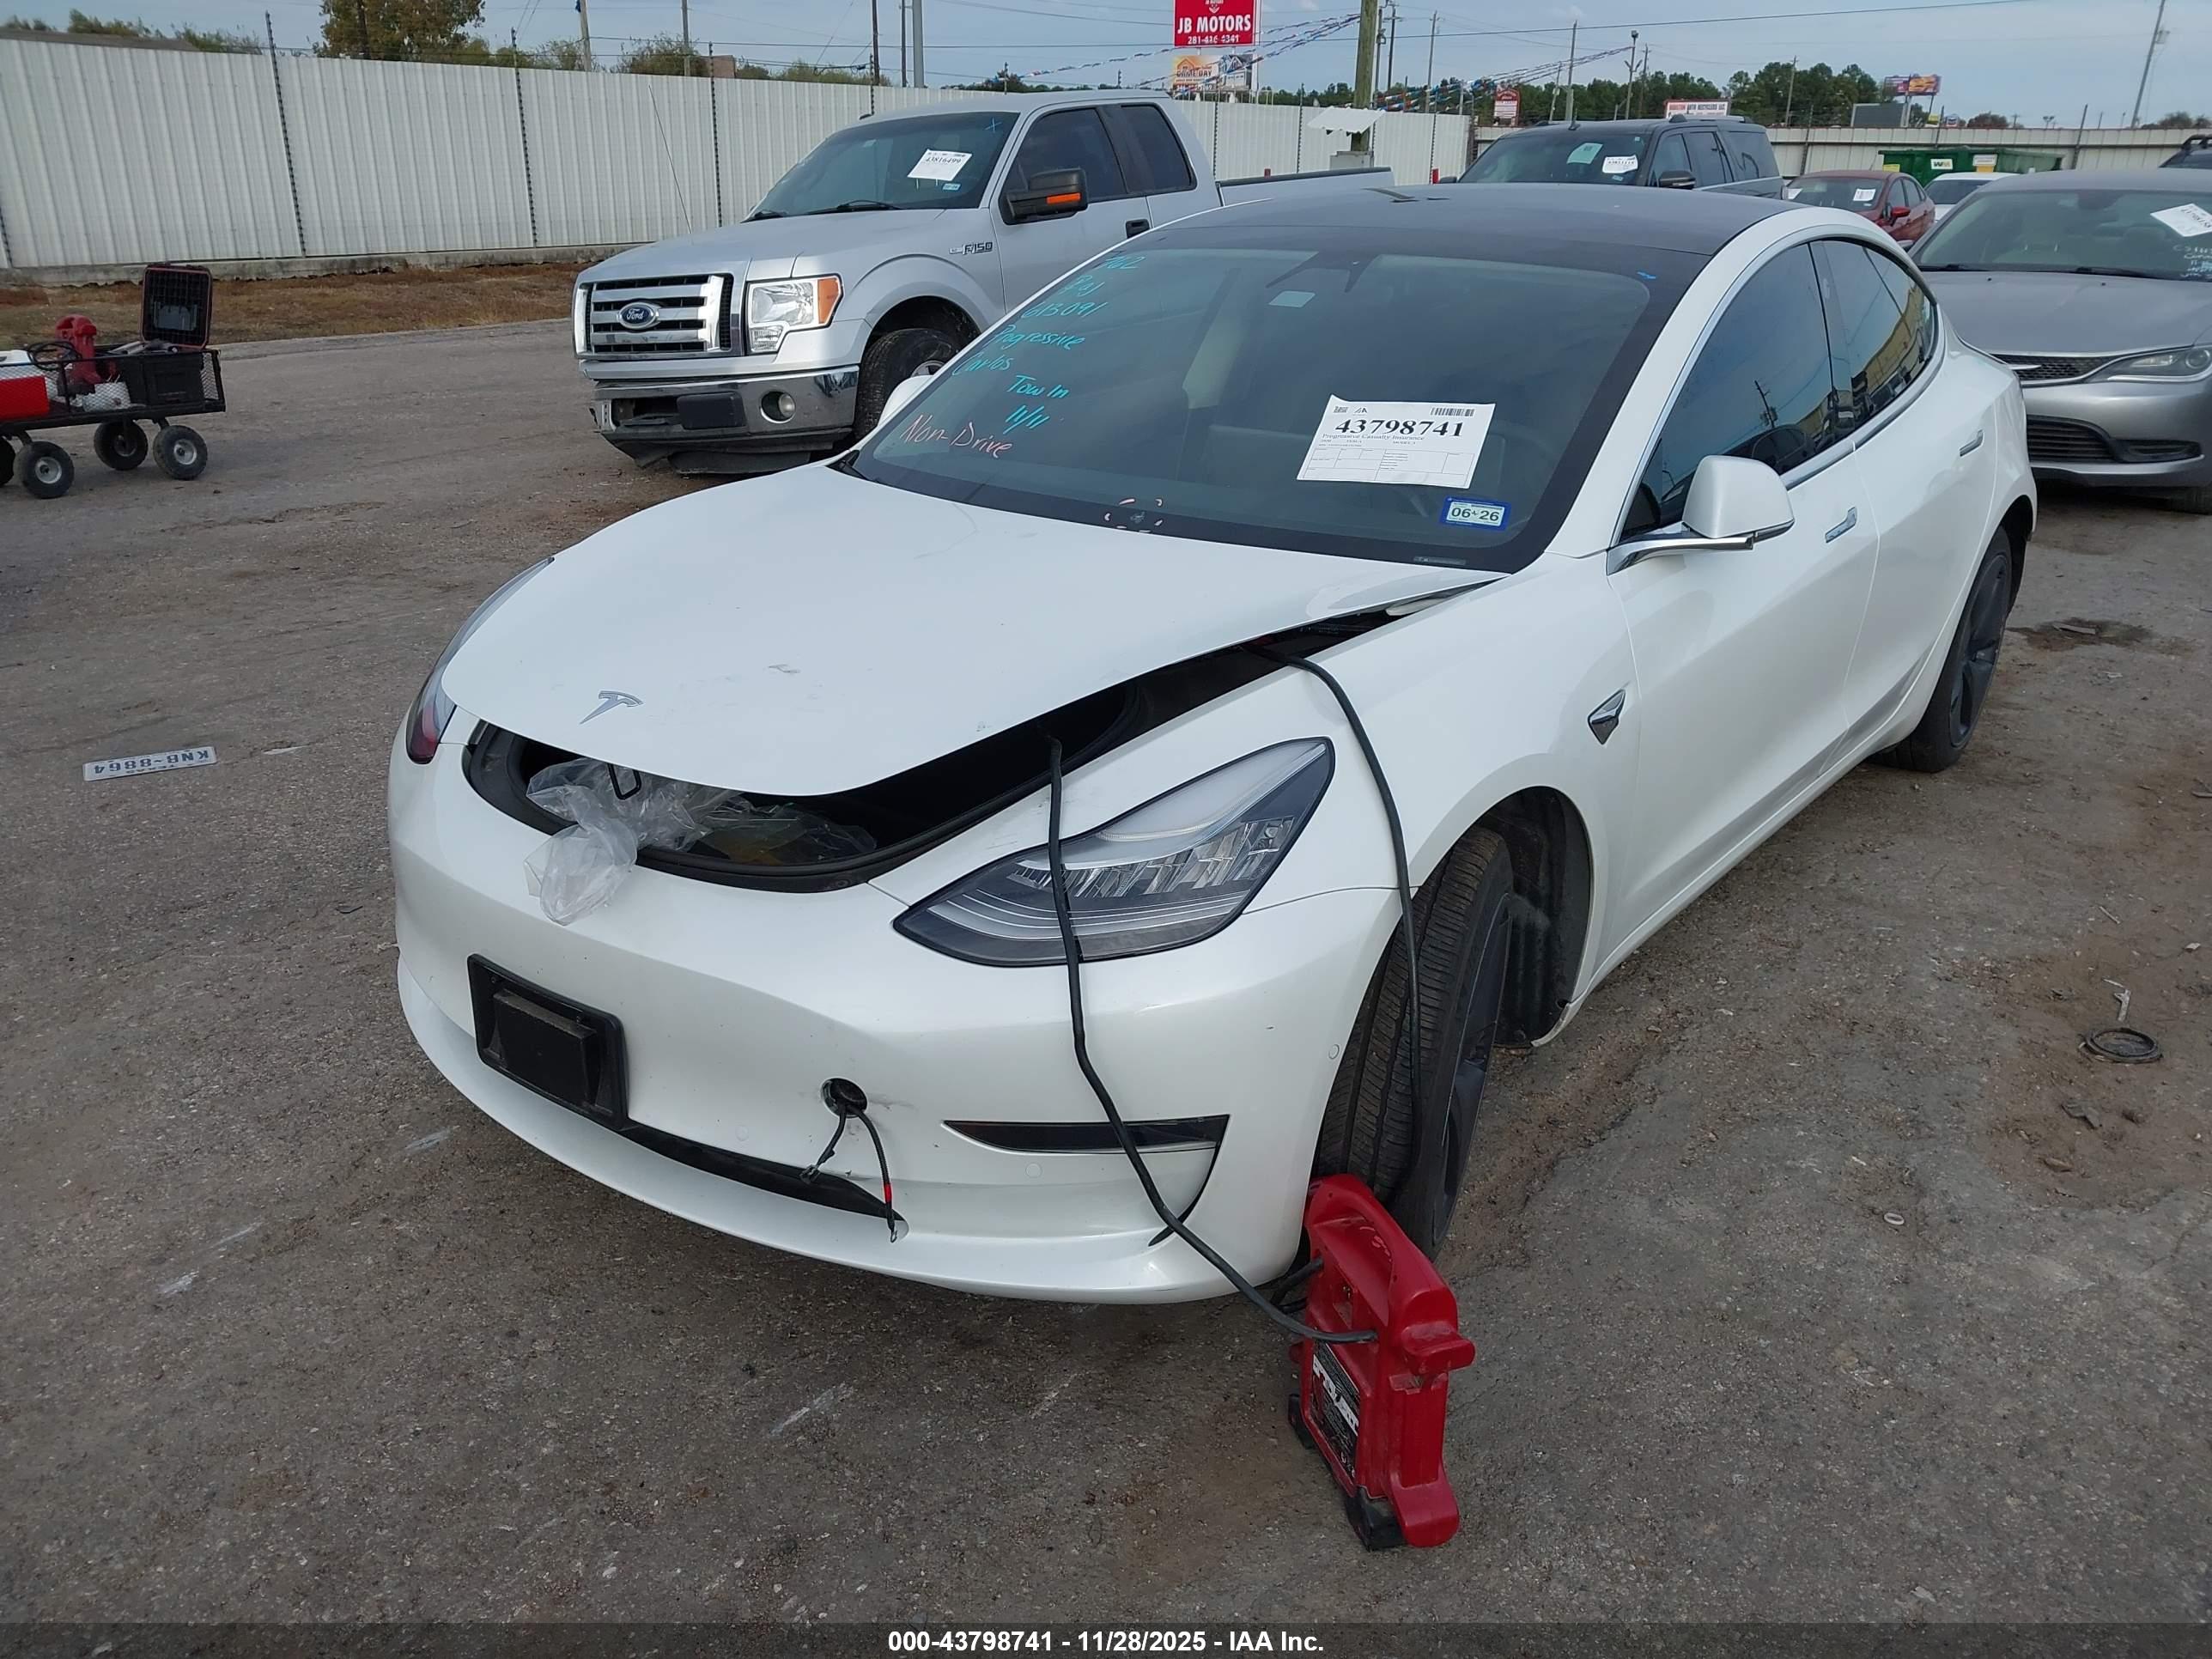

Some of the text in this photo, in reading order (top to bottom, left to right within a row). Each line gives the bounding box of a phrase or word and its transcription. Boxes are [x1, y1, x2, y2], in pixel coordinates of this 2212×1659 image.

[1177, 15, 1251, 33] JB MOTORS
[627, 308, 645, 320] Ford
[1006, 374, 1045, 396] Tow
[1335, 418, 1463, 437] 43798741
[94, 749, 210, 775] KNB-8864
